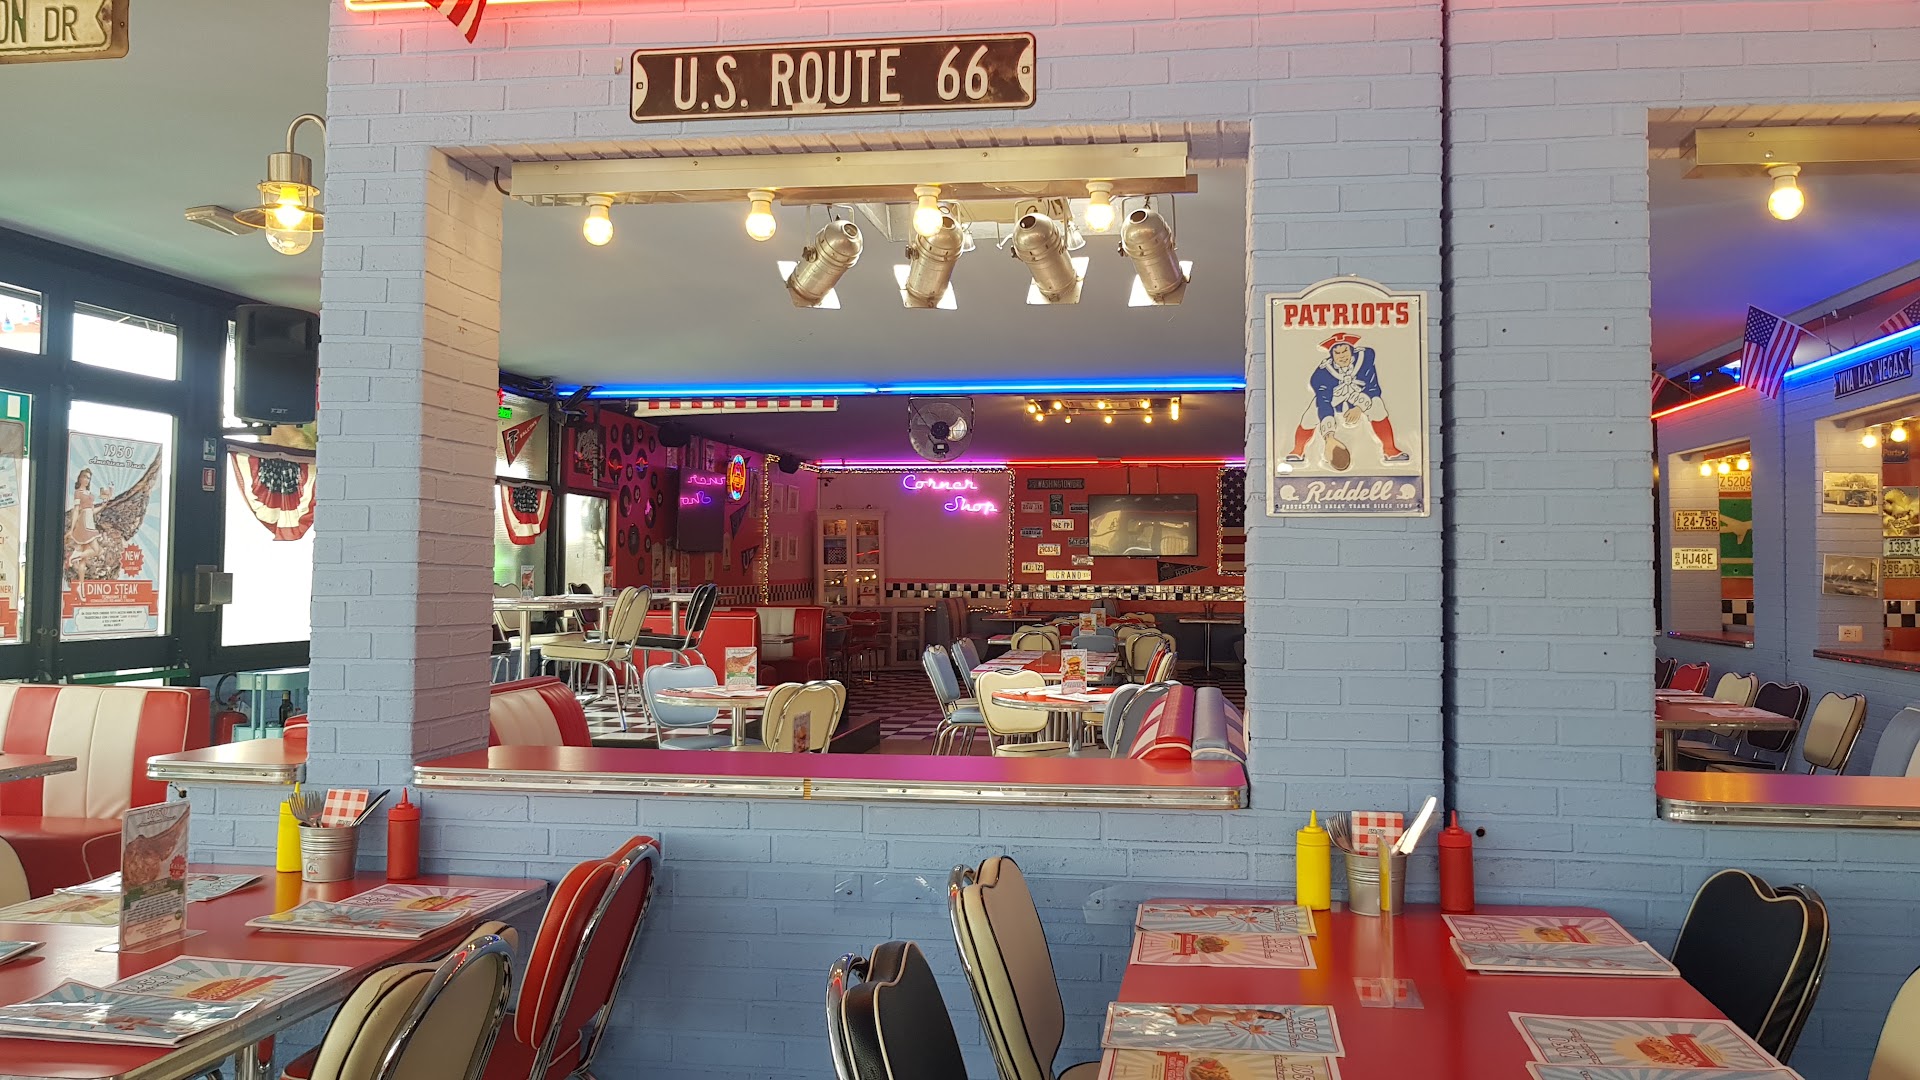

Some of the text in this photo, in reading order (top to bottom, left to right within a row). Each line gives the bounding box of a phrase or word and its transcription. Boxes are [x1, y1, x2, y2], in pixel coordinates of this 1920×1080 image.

[44, 6, 78, 42] DR
[674, 44, 989, 111] U.S. ROUTE 66
[1284, 302, 1409, 327] PATRIOTS
[1839, 351, 1904, 393] VIVA LAS VEGAS
[89, 456, 146, 470] American Diner
[903, 474, 978, 490] Corner
[1302, 480, 1394, 504] Riddell
[944, 495, 998, 515] Shop
[125, 551, 141, 560] NEW
[1682, 553, 1713, 564] HJ48E
[1055, 570, 1081, 580] GRAND
[1175, 566, 1198, 577] HOYAS
[87, 584, 139, 595] DINO STEAK
